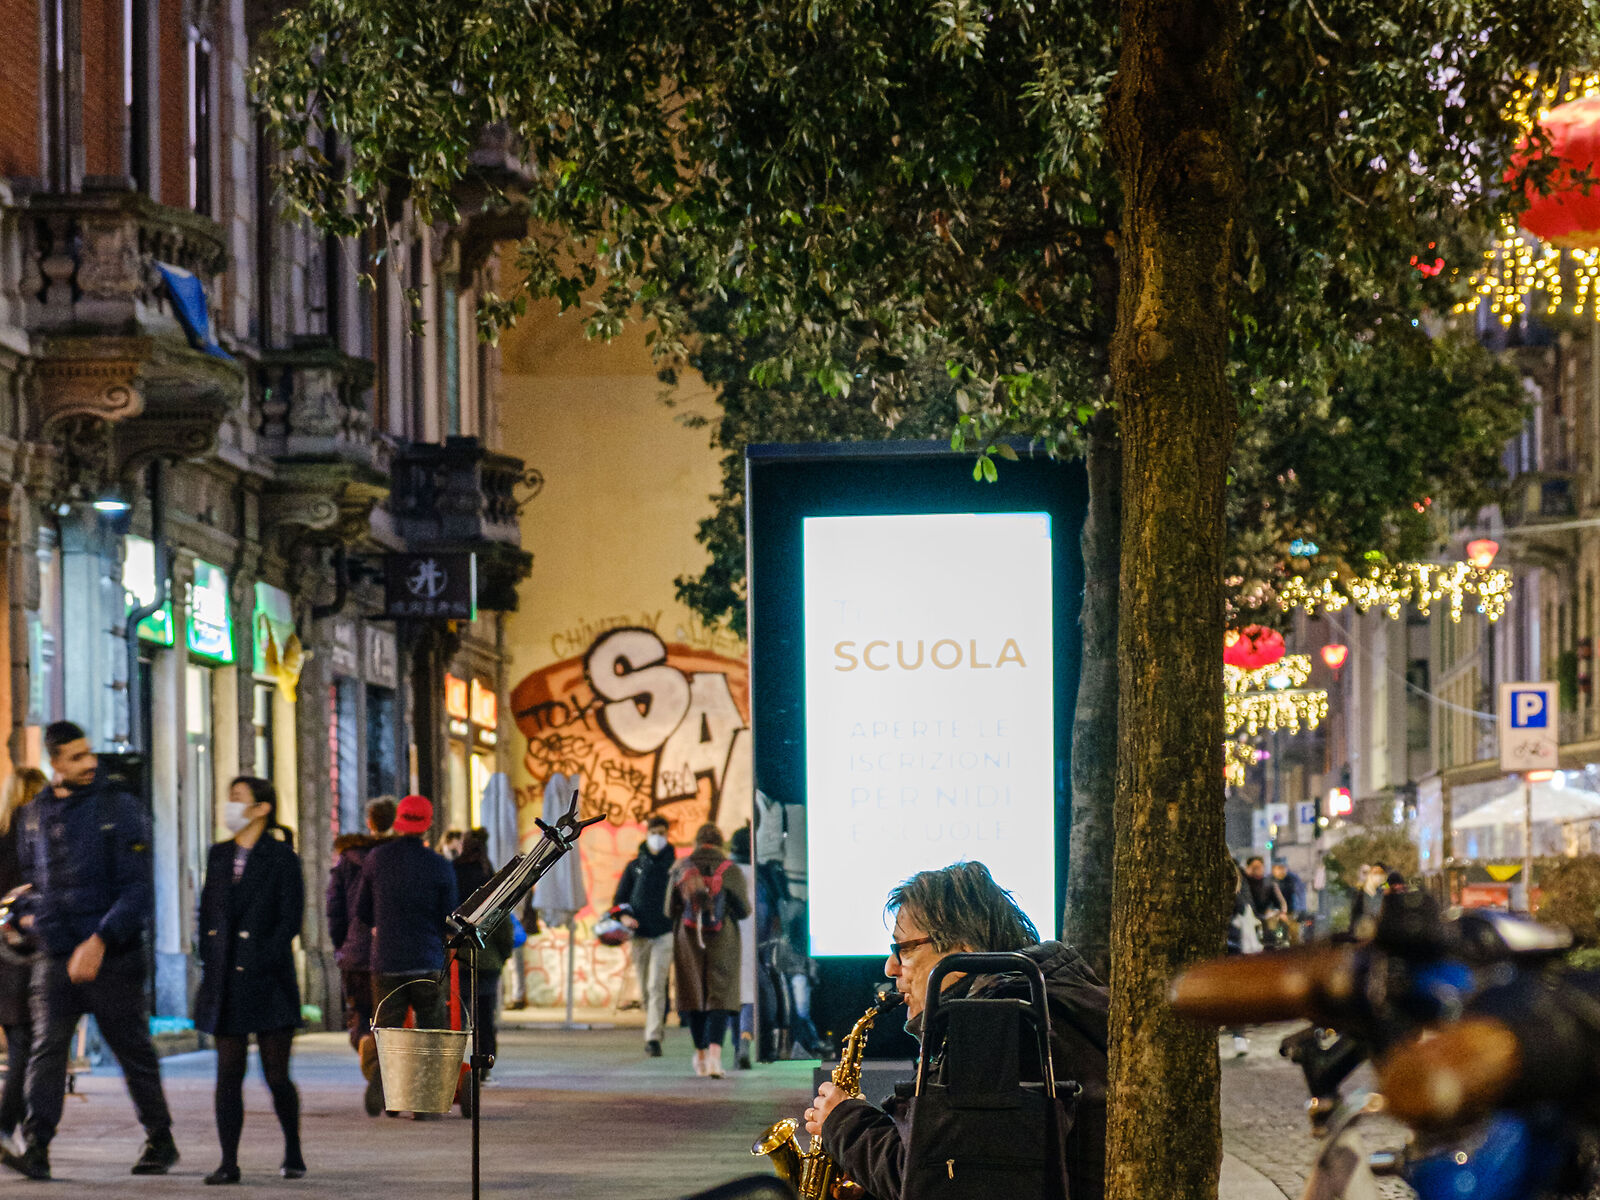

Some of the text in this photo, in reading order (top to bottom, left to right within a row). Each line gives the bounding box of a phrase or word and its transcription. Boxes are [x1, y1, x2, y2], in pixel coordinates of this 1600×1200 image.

[833, 637, 1028, 673] SCUOLA
[1517, 692, 1543, 726] P
[850, 718, 1009, 740] APERTE LE
[850, 751, 1012, 773] ISCRIZIONI
[850, 784, 1012, 808] PER NIDI
